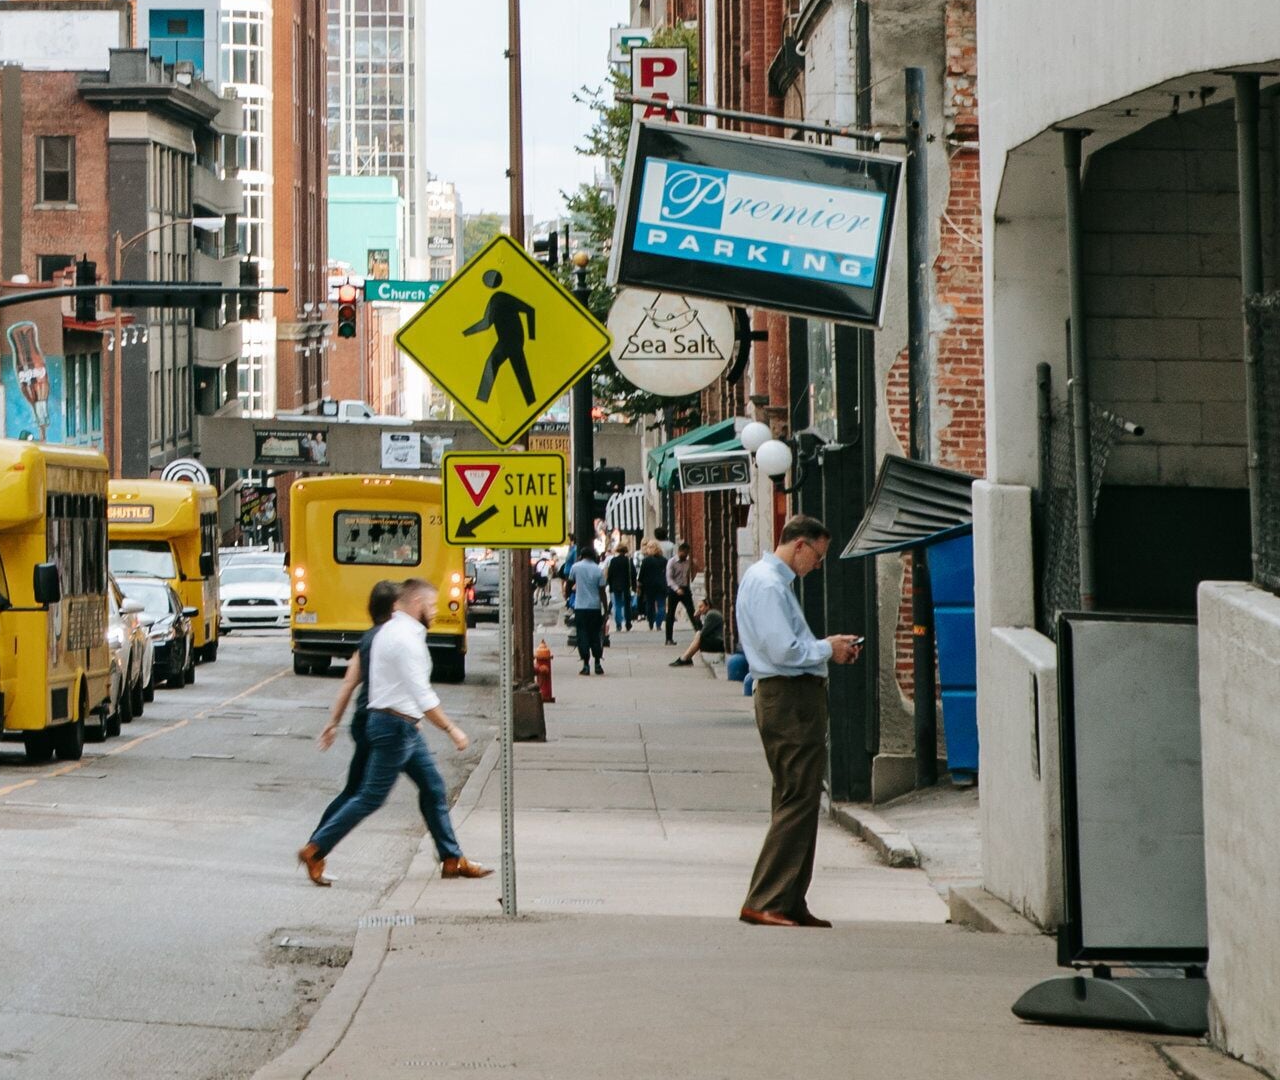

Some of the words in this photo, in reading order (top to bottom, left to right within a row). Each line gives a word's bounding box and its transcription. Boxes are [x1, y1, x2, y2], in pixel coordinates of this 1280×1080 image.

[661, 169, 873, 234] Premier
[647, 228, 862, 278] PARKING
[377, 282, 426, 300] Church
[627, 335, 667, 354] Sea
[673, 333, 716, 354] Salt
[554, 438, 570, 450] SPEC
[504, 473, 558, 496] STATE
[686, 463, 746, 486] GIFTS
[430, 516, 444, 526] 23
[513, 505, 549, 528] LAW
